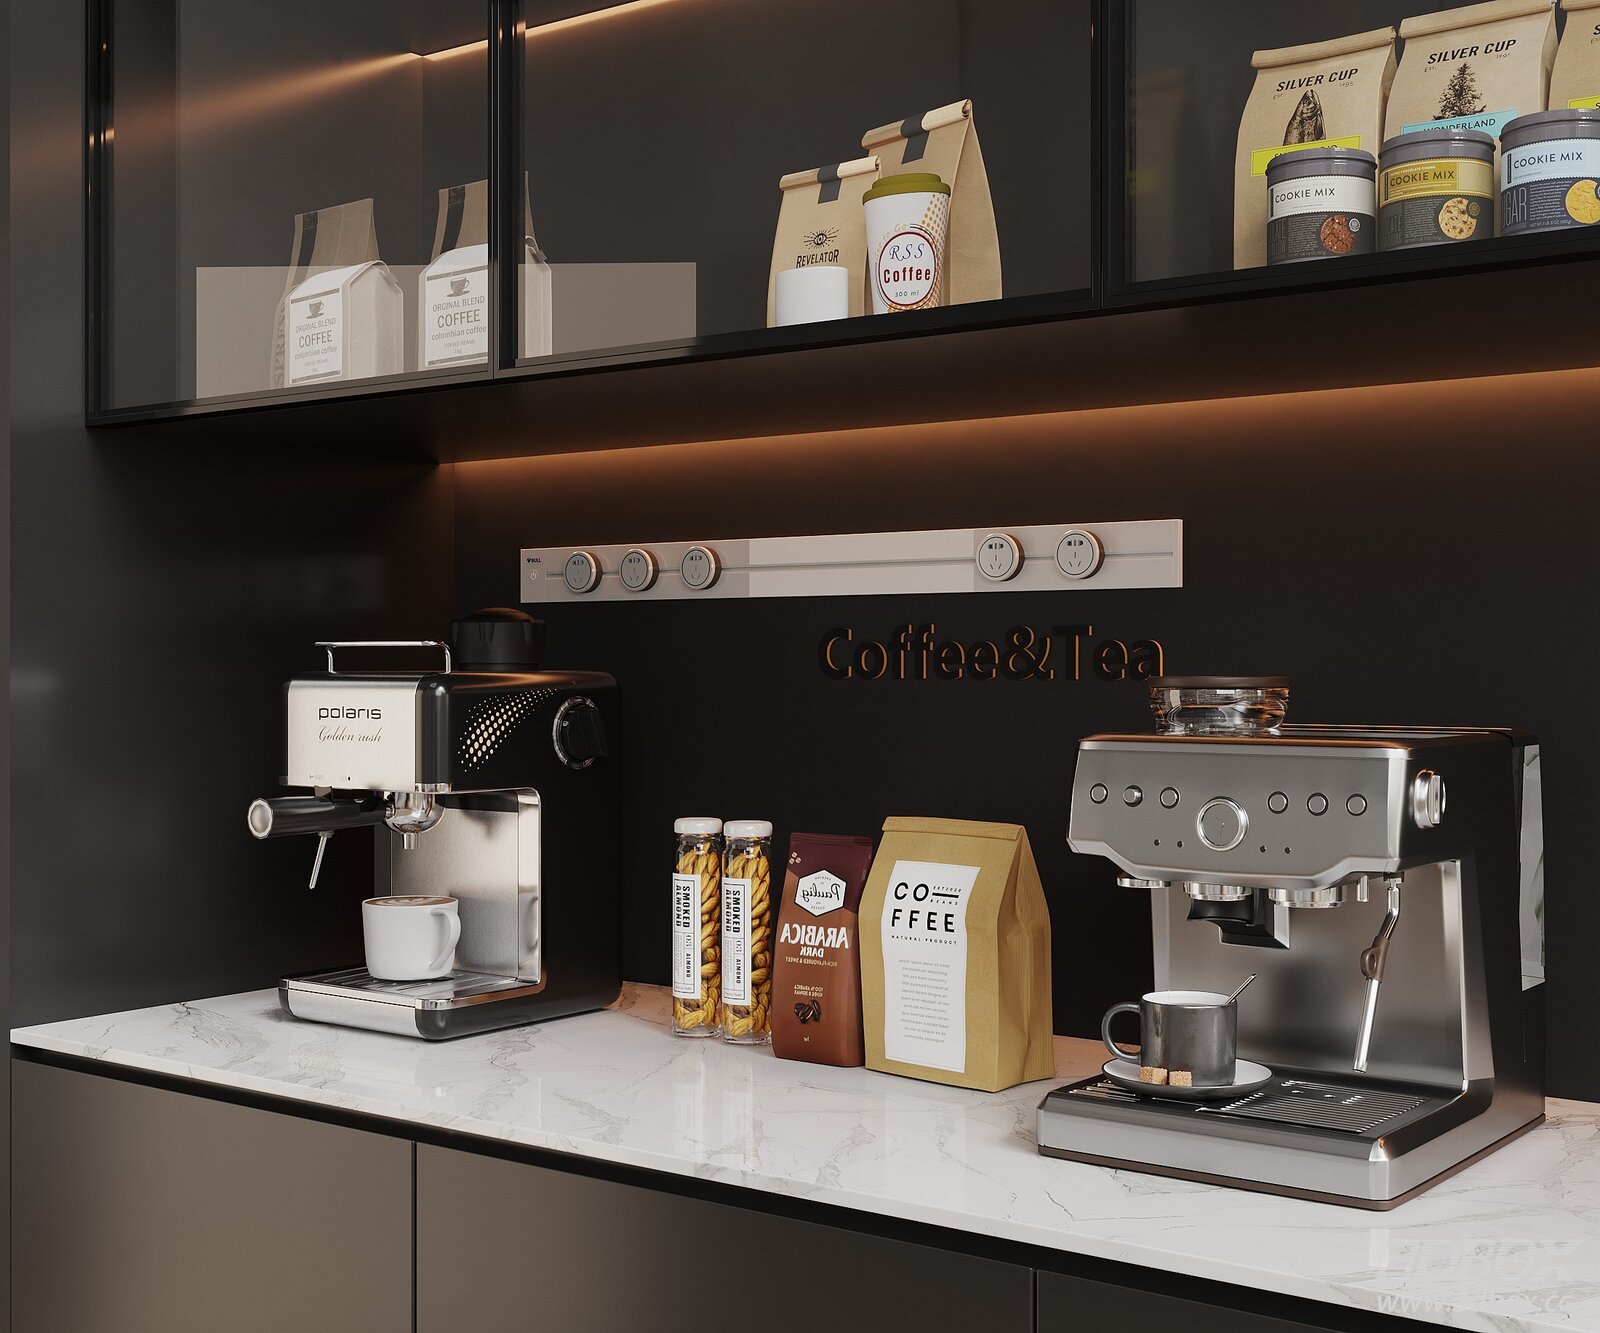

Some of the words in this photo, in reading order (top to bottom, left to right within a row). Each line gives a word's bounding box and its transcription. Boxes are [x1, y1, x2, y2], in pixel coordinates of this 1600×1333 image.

[1427, 45, 1479, 64] SILVER
[1484, 39, 1517, 54] CUP
[1276, 74, 1324, 92] SILVER
[1328, 68, 1358, 83] CUP
[1423, 118, 1496, 131] NDERLAND
[1513, 153, 1556, 169] COOKIE
[1560, 151, 1583, 161] MIX
[1390, 171, 1429, 187] COOKIE
[1432, 170, 1455, 180] MIX
[1274, 189, 1311, 204] COOKIE
[1314, 187, 1336, 197] MIX
[796, 249, 840, 269] REVELATOR
[883, 266, 931, 284] Coffee
[894, 290, 908, 298] 300
[432, 301, 461, 312] ORGINAL
[462, 296, 485, 307] BLEND
[317, 317, 337, 328] BLEND
[437, 309, 481, 328] COFFEE
[298, 330, 333, 348] COFFEE
[431, 329, 465, 341] colombian
[466, 325, 487, 336] coffee
[294, 349, 321, 360] colombian
[321, 345, 337, 356] coffee
[818, 624, 1165, 681] Coffee&Tea
[318, 706, 381, 720] polaris
[318, 724, 355, 743] Golden
[357, 727, 383, 742] rush
[894, 881, 930, 902] CO
[682, 885, 691, 928] SMOKED
[732, 890, 740, 933] SMOKED
[891, 908, 955, 933] FFEE
